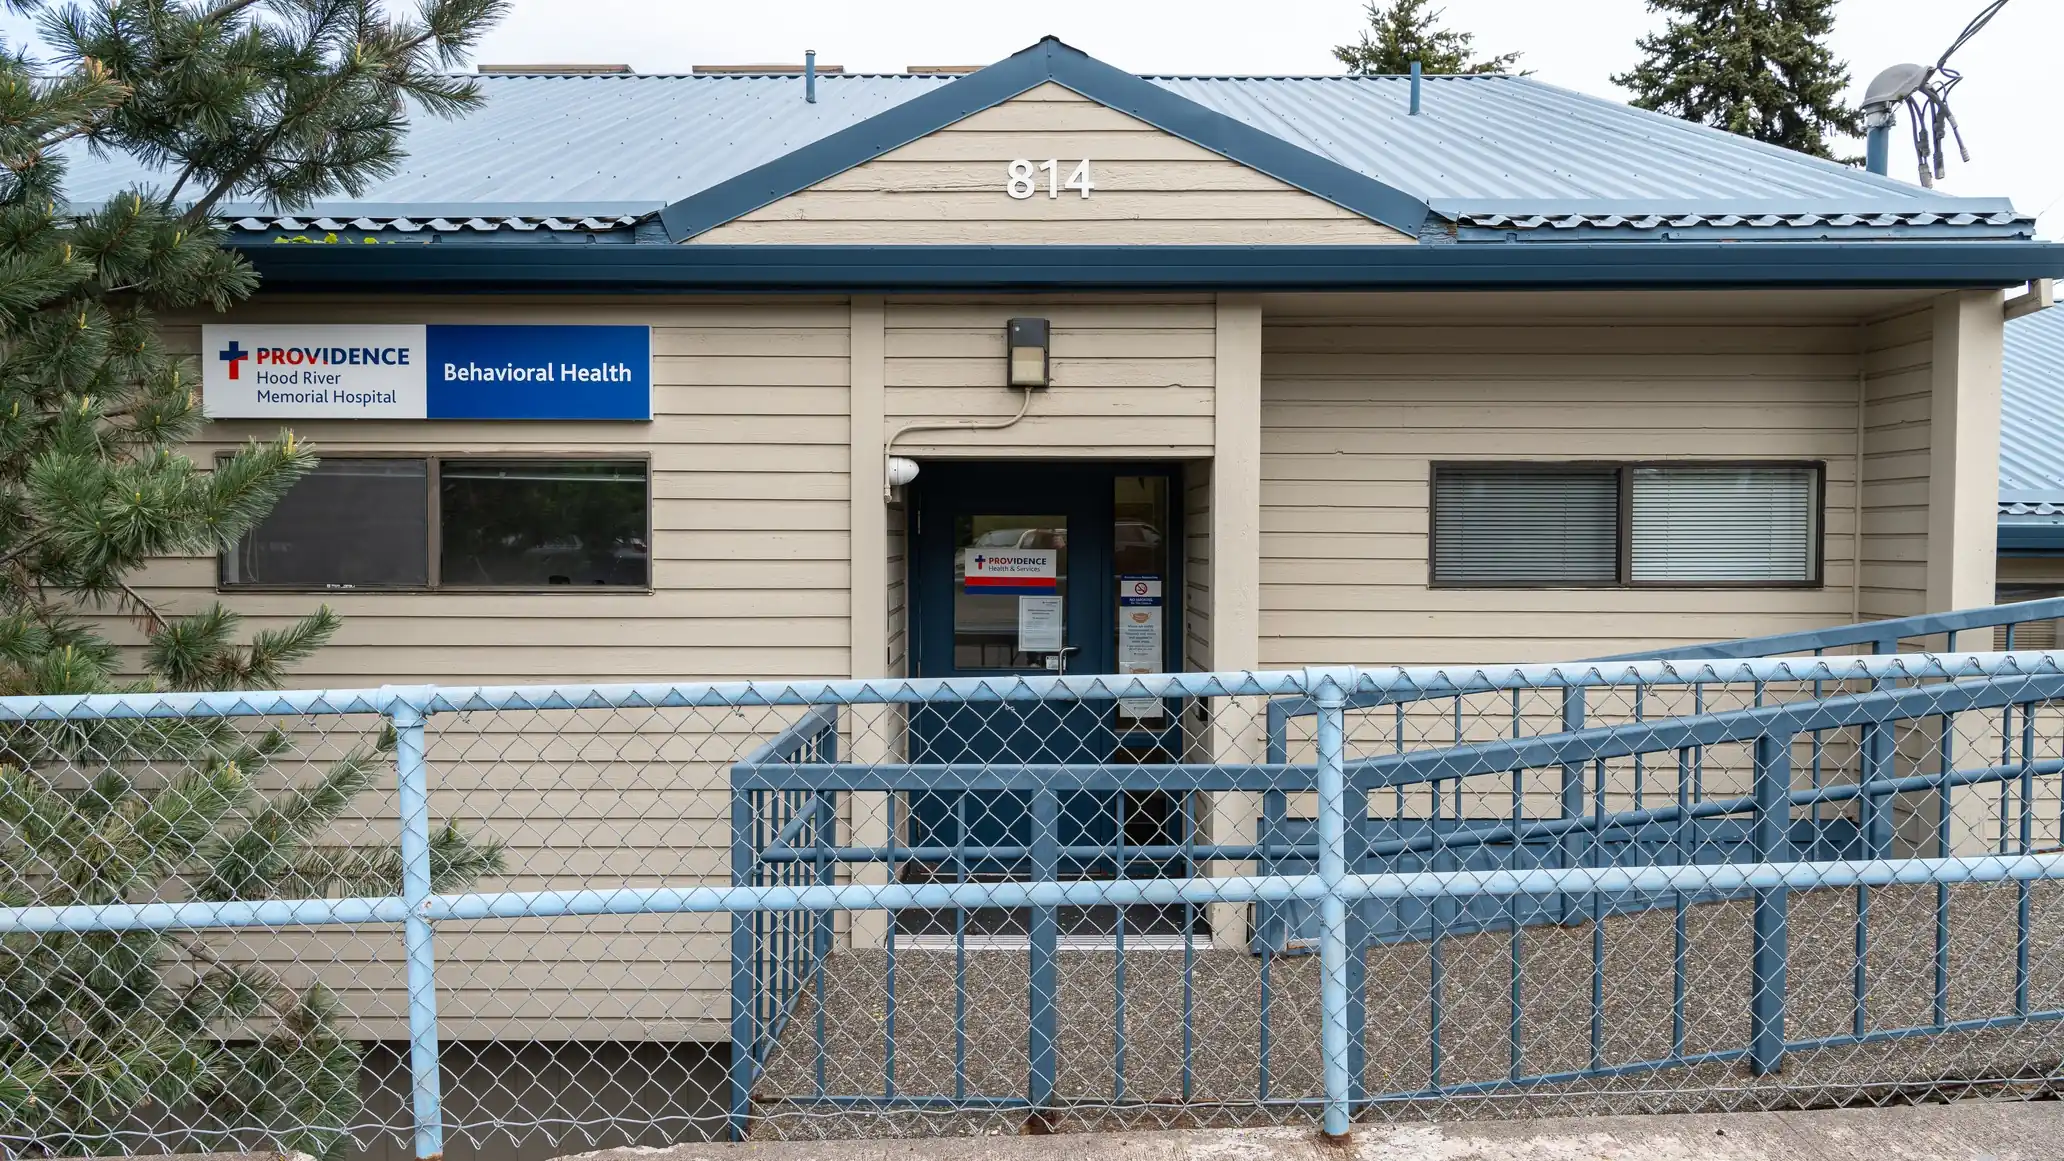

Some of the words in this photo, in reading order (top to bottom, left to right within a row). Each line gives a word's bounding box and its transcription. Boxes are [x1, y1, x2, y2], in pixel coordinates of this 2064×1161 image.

[1007, 158, 1095, 199] 814
[256, 347, 410, 365] PROVIDENCE
[256, 371, 298, 385] Hood
[303, 371, 342, 385] River
[444, 362, 554, 382] Behavioral
[561, 362, 632, 382] Health
[257, 390, 328, 404] Memorial
[333, 390, 396, 407] Hospital
[988, 557, 1047, 565] PROVIDENCE
[1016, 565, 1040, 573] Services
